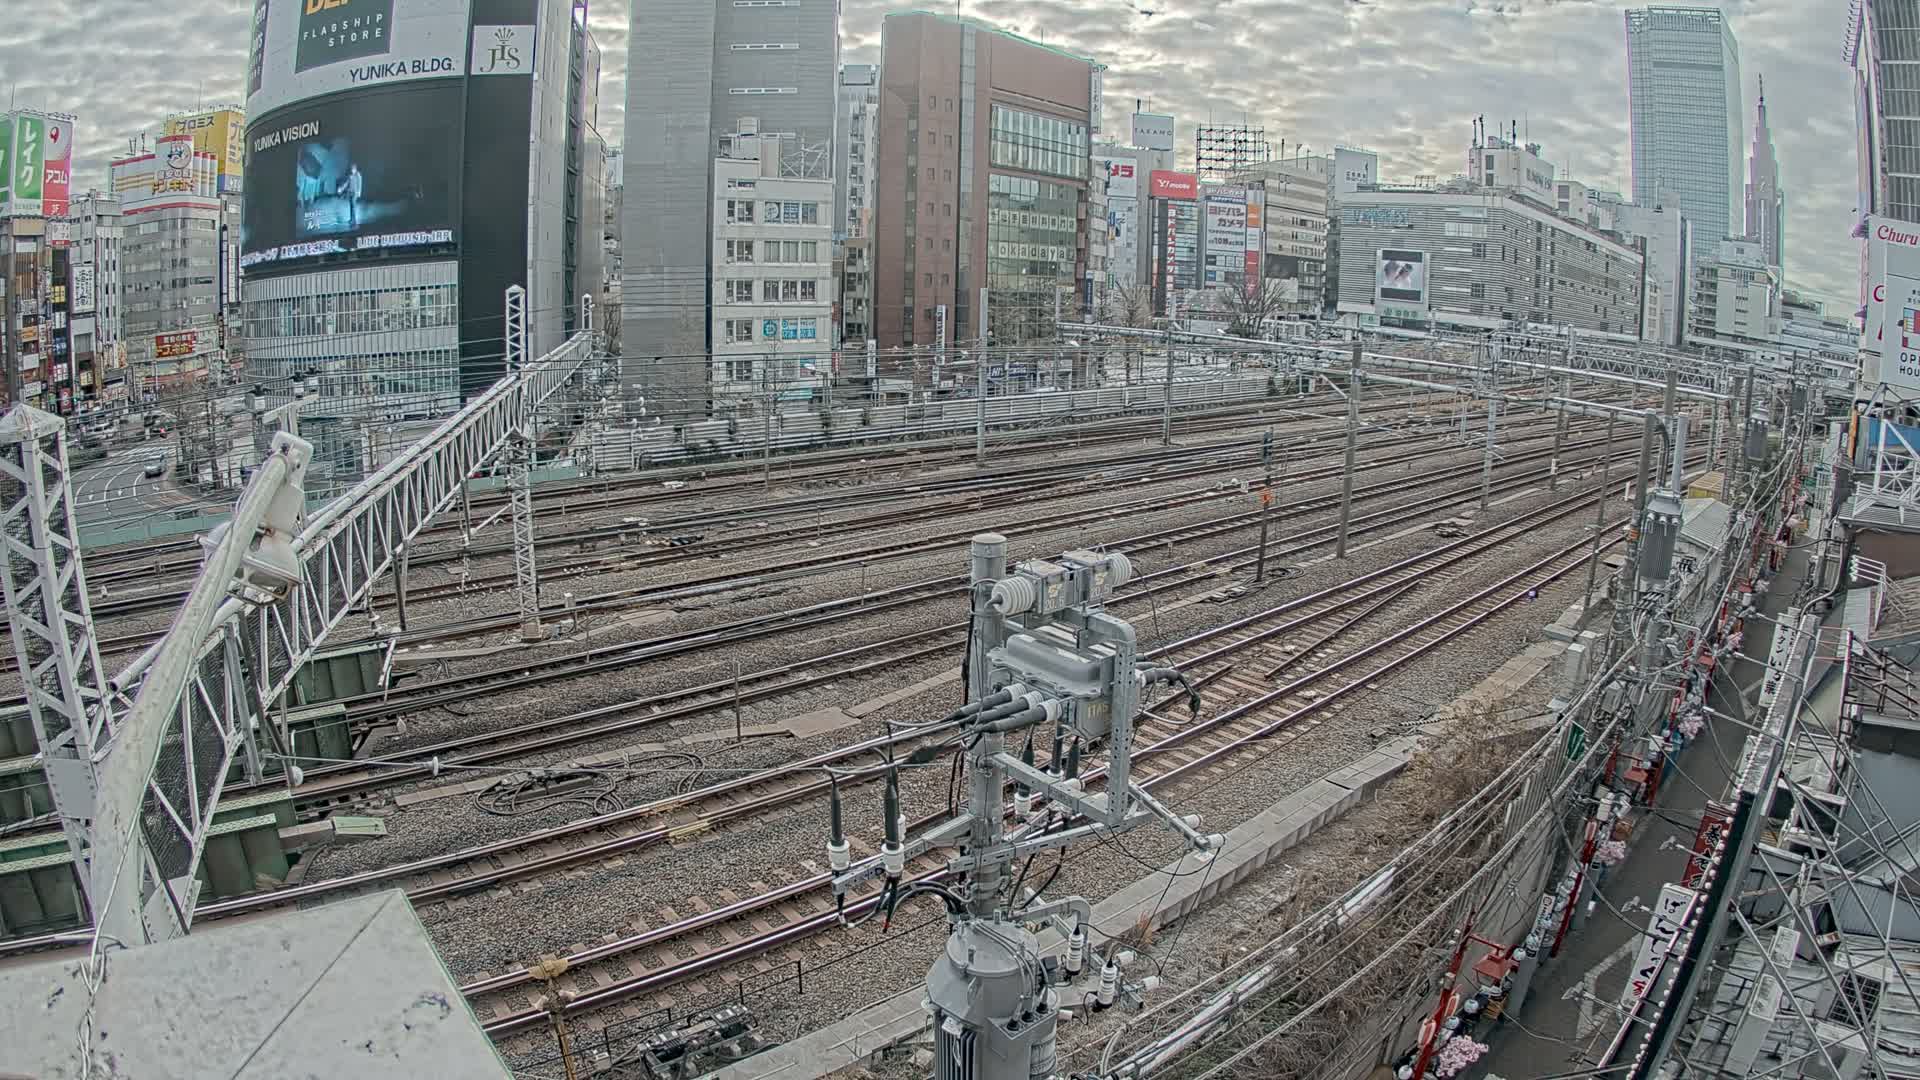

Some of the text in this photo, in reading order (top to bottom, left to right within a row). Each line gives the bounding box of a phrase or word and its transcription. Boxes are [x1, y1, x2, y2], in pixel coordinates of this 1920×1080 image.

[303, 13, 383, 41] FLAGSHIP
[328, 27, 383, 47] STORE
[349, 57, 456, 84] YUNIKA BLDG.
[176, 115, 215, 131] プロミス
[254, 128, 281, 153] YUNIKA
[282, 120, 320, 144] VISION
[20, 120, 37, 188] レイク
[45, 169, 68, 185] アコム
[1208, 205, 1245, 217] ヨドバシ
[1217, 218, 1245, 228] カメラ
[1877, 224, 1919, 246] Churu
[999, 244, 1066, 261] okadaya
